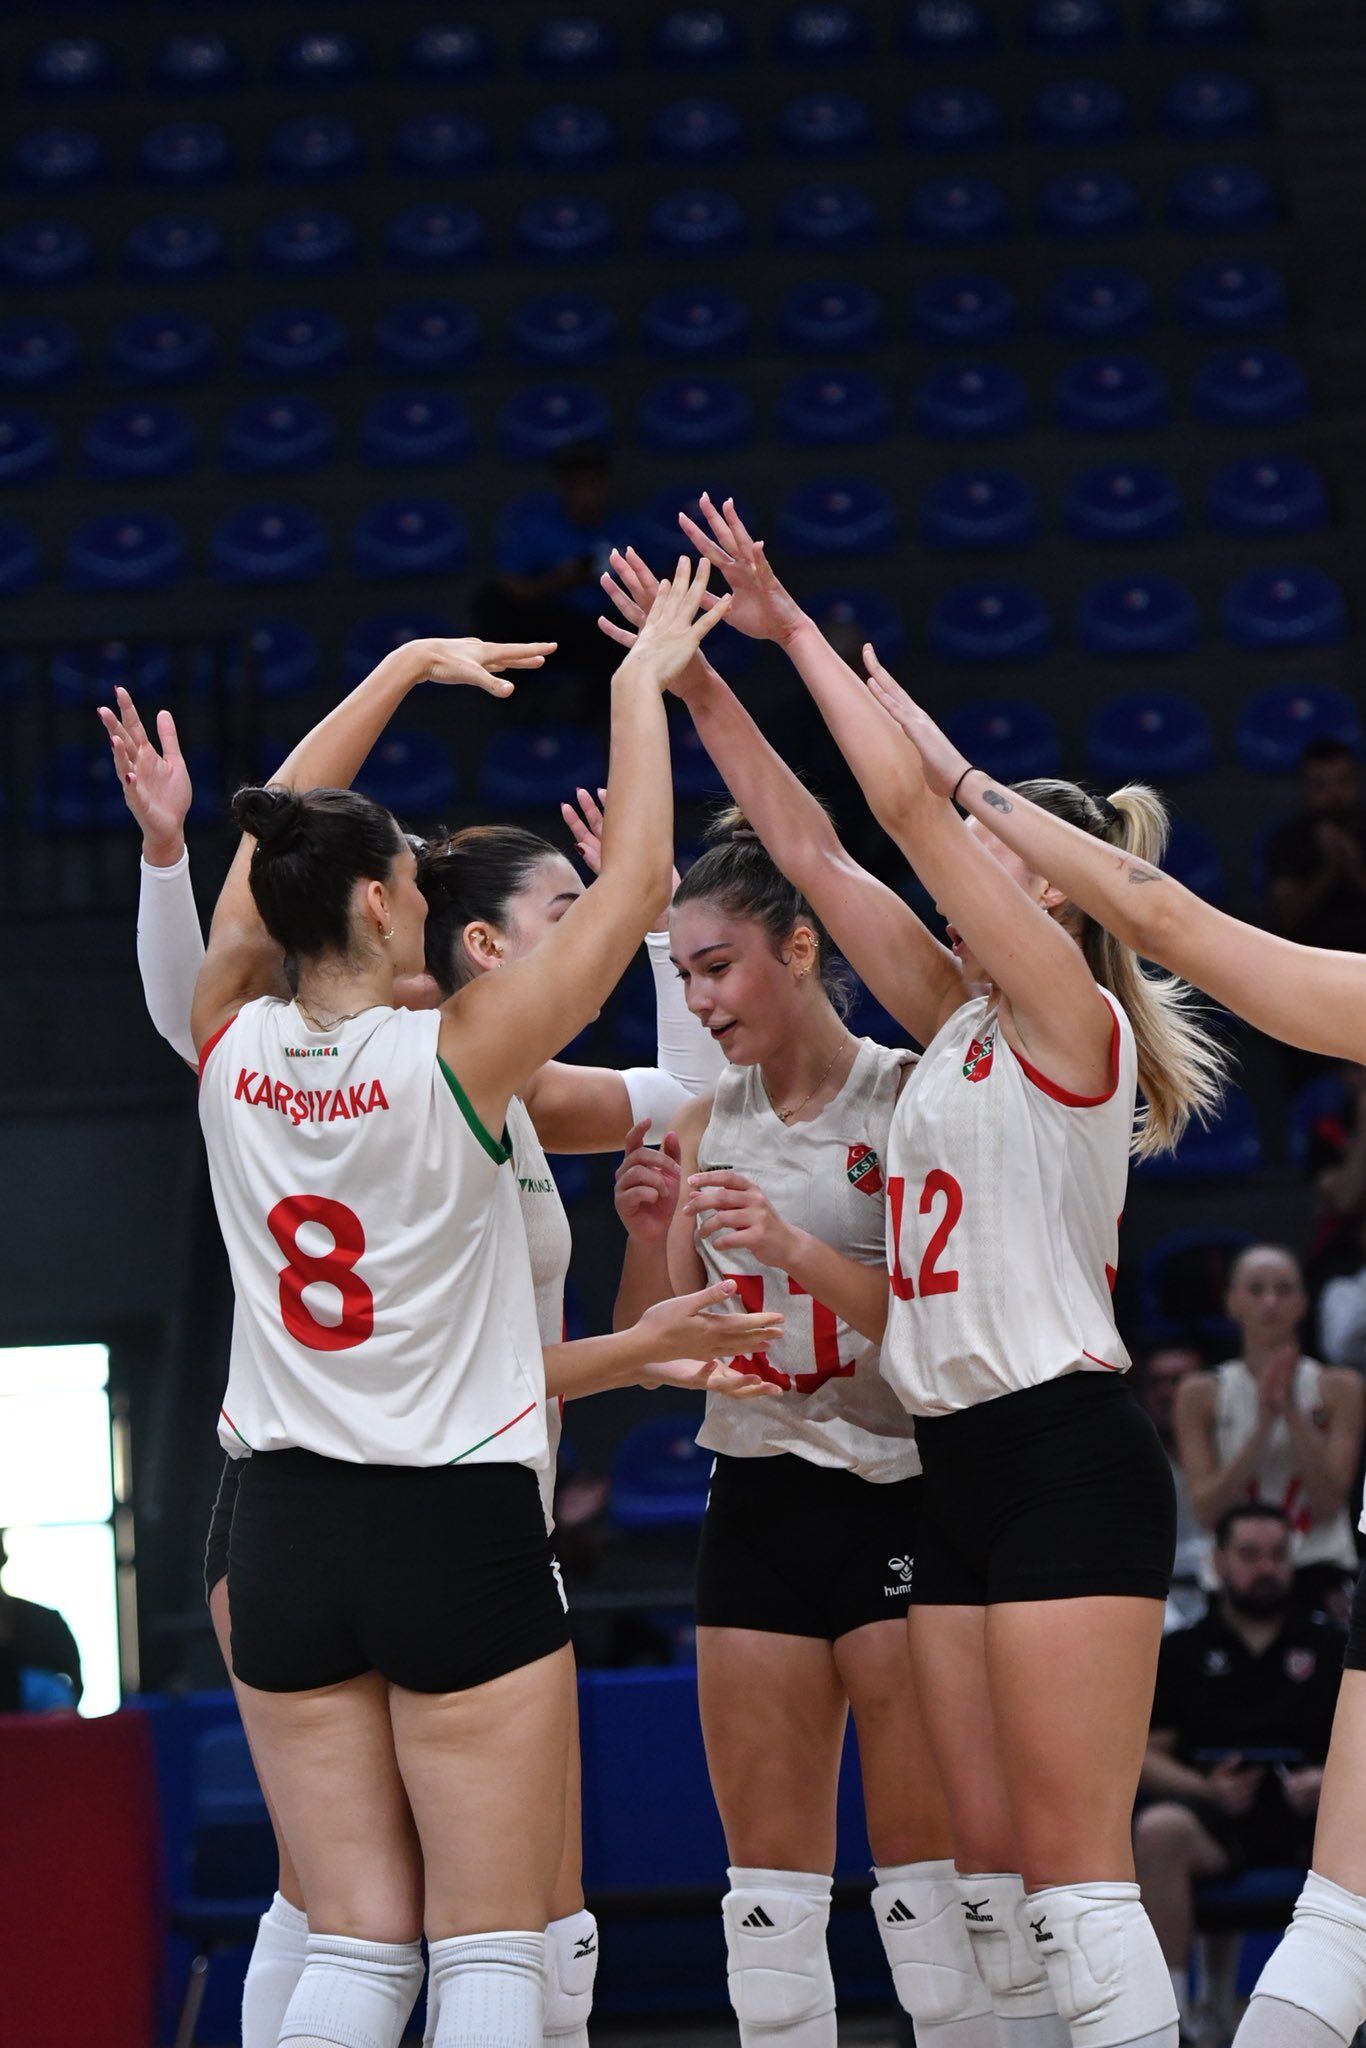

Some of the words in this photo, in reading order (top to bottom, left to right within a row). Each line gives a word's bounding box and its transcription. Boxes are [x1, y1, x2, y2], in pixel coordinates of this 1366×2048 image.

[234, 1068, 389, 1126] KARŞIYAKA
[267, 1195, 374, 1352] 8
[887, 1169, 963, 1301] 12
